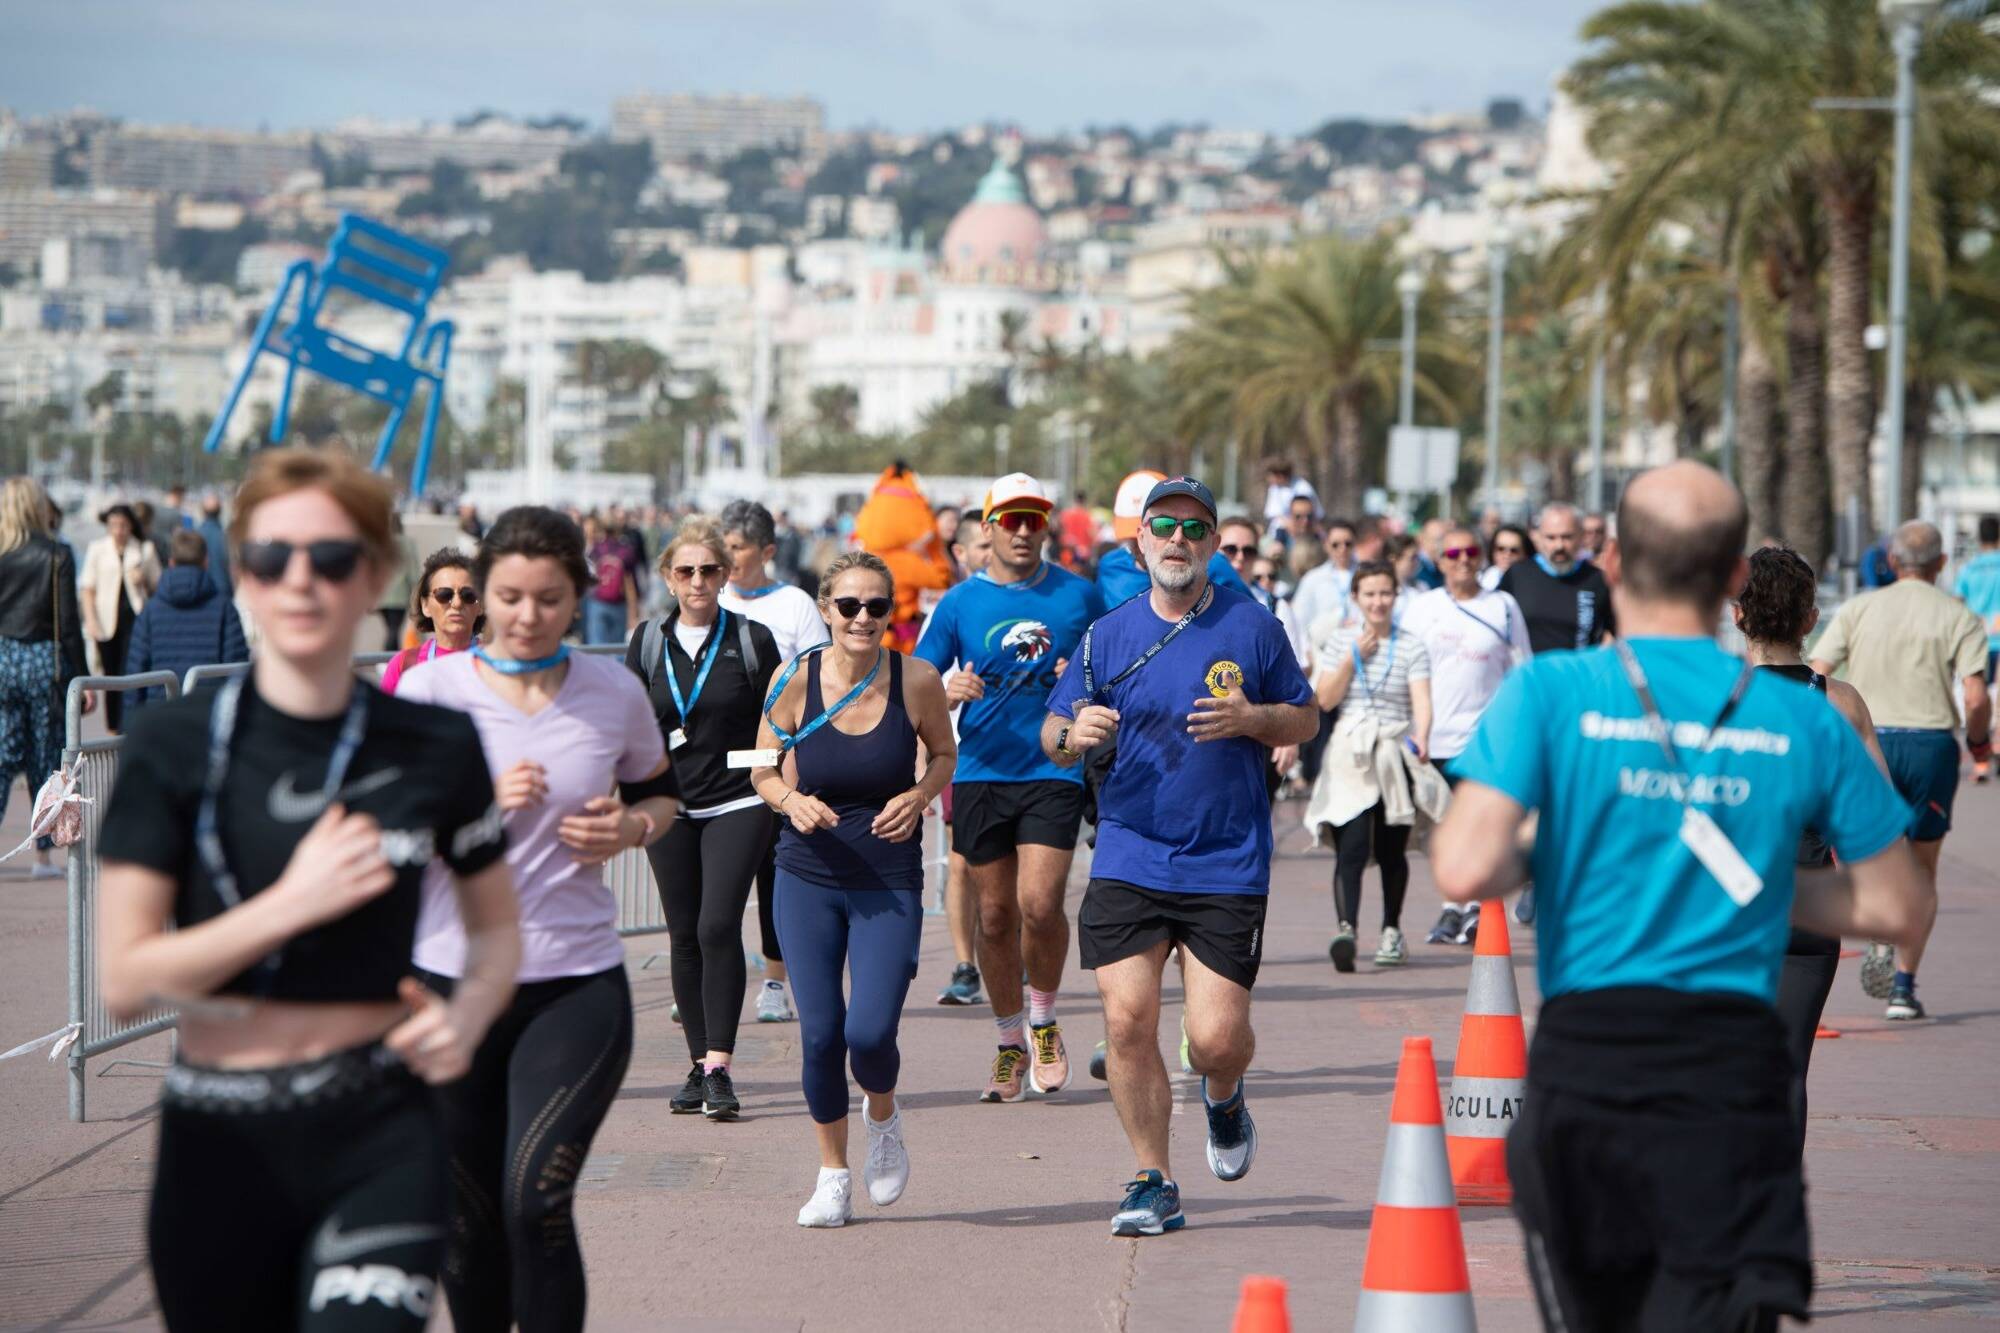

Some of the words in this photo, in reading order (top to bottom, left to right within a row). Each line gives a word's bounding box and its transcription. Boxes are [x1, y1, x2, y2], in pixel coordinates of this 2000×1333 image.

[1176, 611, 1195, 630] FCNA
[1619, 766, 1751, 806] MONACO
[309, 1263, 437, 1318] PRO
